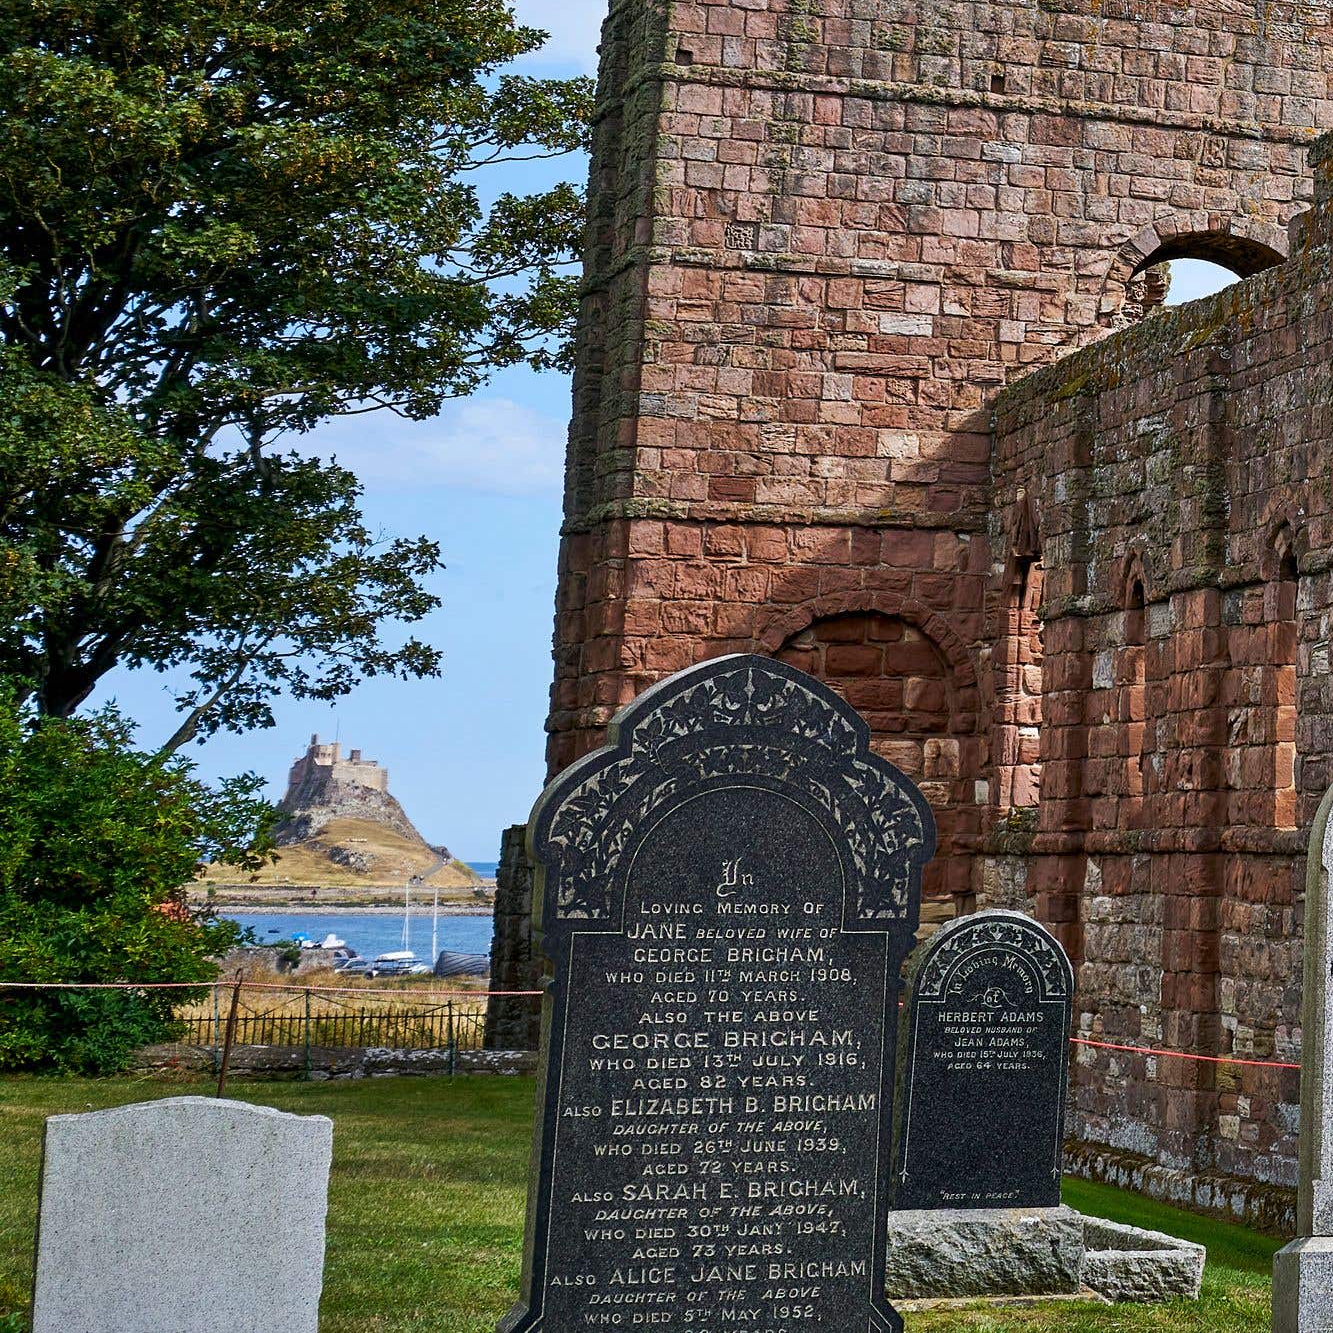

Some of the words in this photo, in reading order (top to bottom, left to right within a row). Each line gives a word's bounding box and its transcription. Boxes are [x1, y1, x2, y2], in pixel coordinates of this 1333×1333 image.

[717, 858, 753, 897] In
[641, 902, 702, 913] LOVING
[718, 903, 790, 913] MEMORY
[804, 902, 824, 913] OF
[628, 924, 686, 939] JANE
[696, 929, 765, 938] BELOVED
[778, 929, 812, 938] WIFE
[820, 928, 837, 938] OF
[635, 949, 711, 962] GEORGE
[728, 948, 832, 965] BRIGHAM,
[606, 973, 643, 982] WHO
[656, 972, 695, 982] DIED
[740, 971, 800, 982] MARCH
[811, 969, 857, 985] 1908,
[957, 956, 997, 980] Loving
[1000, 954, 1033, 994] Memory
[651, 992, 696, 1003] AGED
[709, 990, 728, 1002] 70
[742, 991, 804, 1001] YEARS.
[639, 1013, 686, 1024] ALSO
[704, 1012, 742, 1022] THE
[754, 1010, 818, 1021] ABOVE
[938, 1012, 994, 1022] HERBERT
[1001, 1012, 1044, 1021] ADAMS
[593, 1033, 708, 1049] GEORGE
[725, 1031, 860, 1049] BRIGHAM,
[955, 1038, 983, 1047] JEAN
[590, 1059, 635, 1070] WHO
[648, 1058, 690, 1068] DIED
[753, 1056, 804, 1066] JULY
[819, 1053, 865, 1069] 1916,
[635, 1079, 687, 1089] AGED
[701, 1075, 725, 1088] 82
[738, 1076, 813, 1087] YEARS.
[563, 1106, 601, 1116] ALSO
[612, 1098, 732, 1116] ELIZABETH
[746, 1097, 764, 1112] B.
[774, 1095, 875, 1112] BRIGHAM
[613, 1124, 698, 1135] DAUGHTER
[709, 1123, 729, 1133] OF
[738, 1122, 765, 1132] THE
[772, 1121, 826, 1133] ABOVE,
[594, 1145, 632, 1155] WHO
[642, 1144, 681, 1154] DIED
[741, 1141, 785, 1152] JUNE
[798, 1138, 845, 1154] 1939,
[643, 1164, 687, 1175] AGED
[700, 1161, 721, 1173] 72
[732, 1161, 795, 1172] YEARS.
[572, 1192, 612, 1202] ALSO
[623, 1183, 706, 1200] SARAH
[720, 1183, 738, 1198] E.
[749, 1180, 864, 1198] BRIGHAM,
[595, 1209, 687, 1220] DAUGHTER
[699, 1208, 721, 1217] OF
[731, 1207, 762, 1216] THE
[769, 1204, 832, 1217] ABOVE,
[585, 1230, 625, 1240] WHO
[636, 1229, 675, 1238] DIED
[798, 1221, 845, 1236] 1947,
[632, 1248, 679, 1258] AGED
[693, 1244, 715, 1257] 73
[725, 1244, 791, 1256] YEARS.
[551, 1275, 595, 1285] ALSO
[609, 1268, 674, 1284] ALICE
[691, 1265, 756, 1282] JANE
[769, 1261, 865, 1279] BRIGHAM
[589, 1293, 676, 1304] DAUGHTER
[687, 1292, 708, 1301] OF
[719, 1290, 746, 1300] THE
[762, 1287, 820, 1299] ABOVE
[585, 1314, 621, 1323] WHO
[633, 1313, 671, 1323] DIED
[722, 1309, 761, 1320] MAY
[774, 1305, 821, 1321] 1952,
